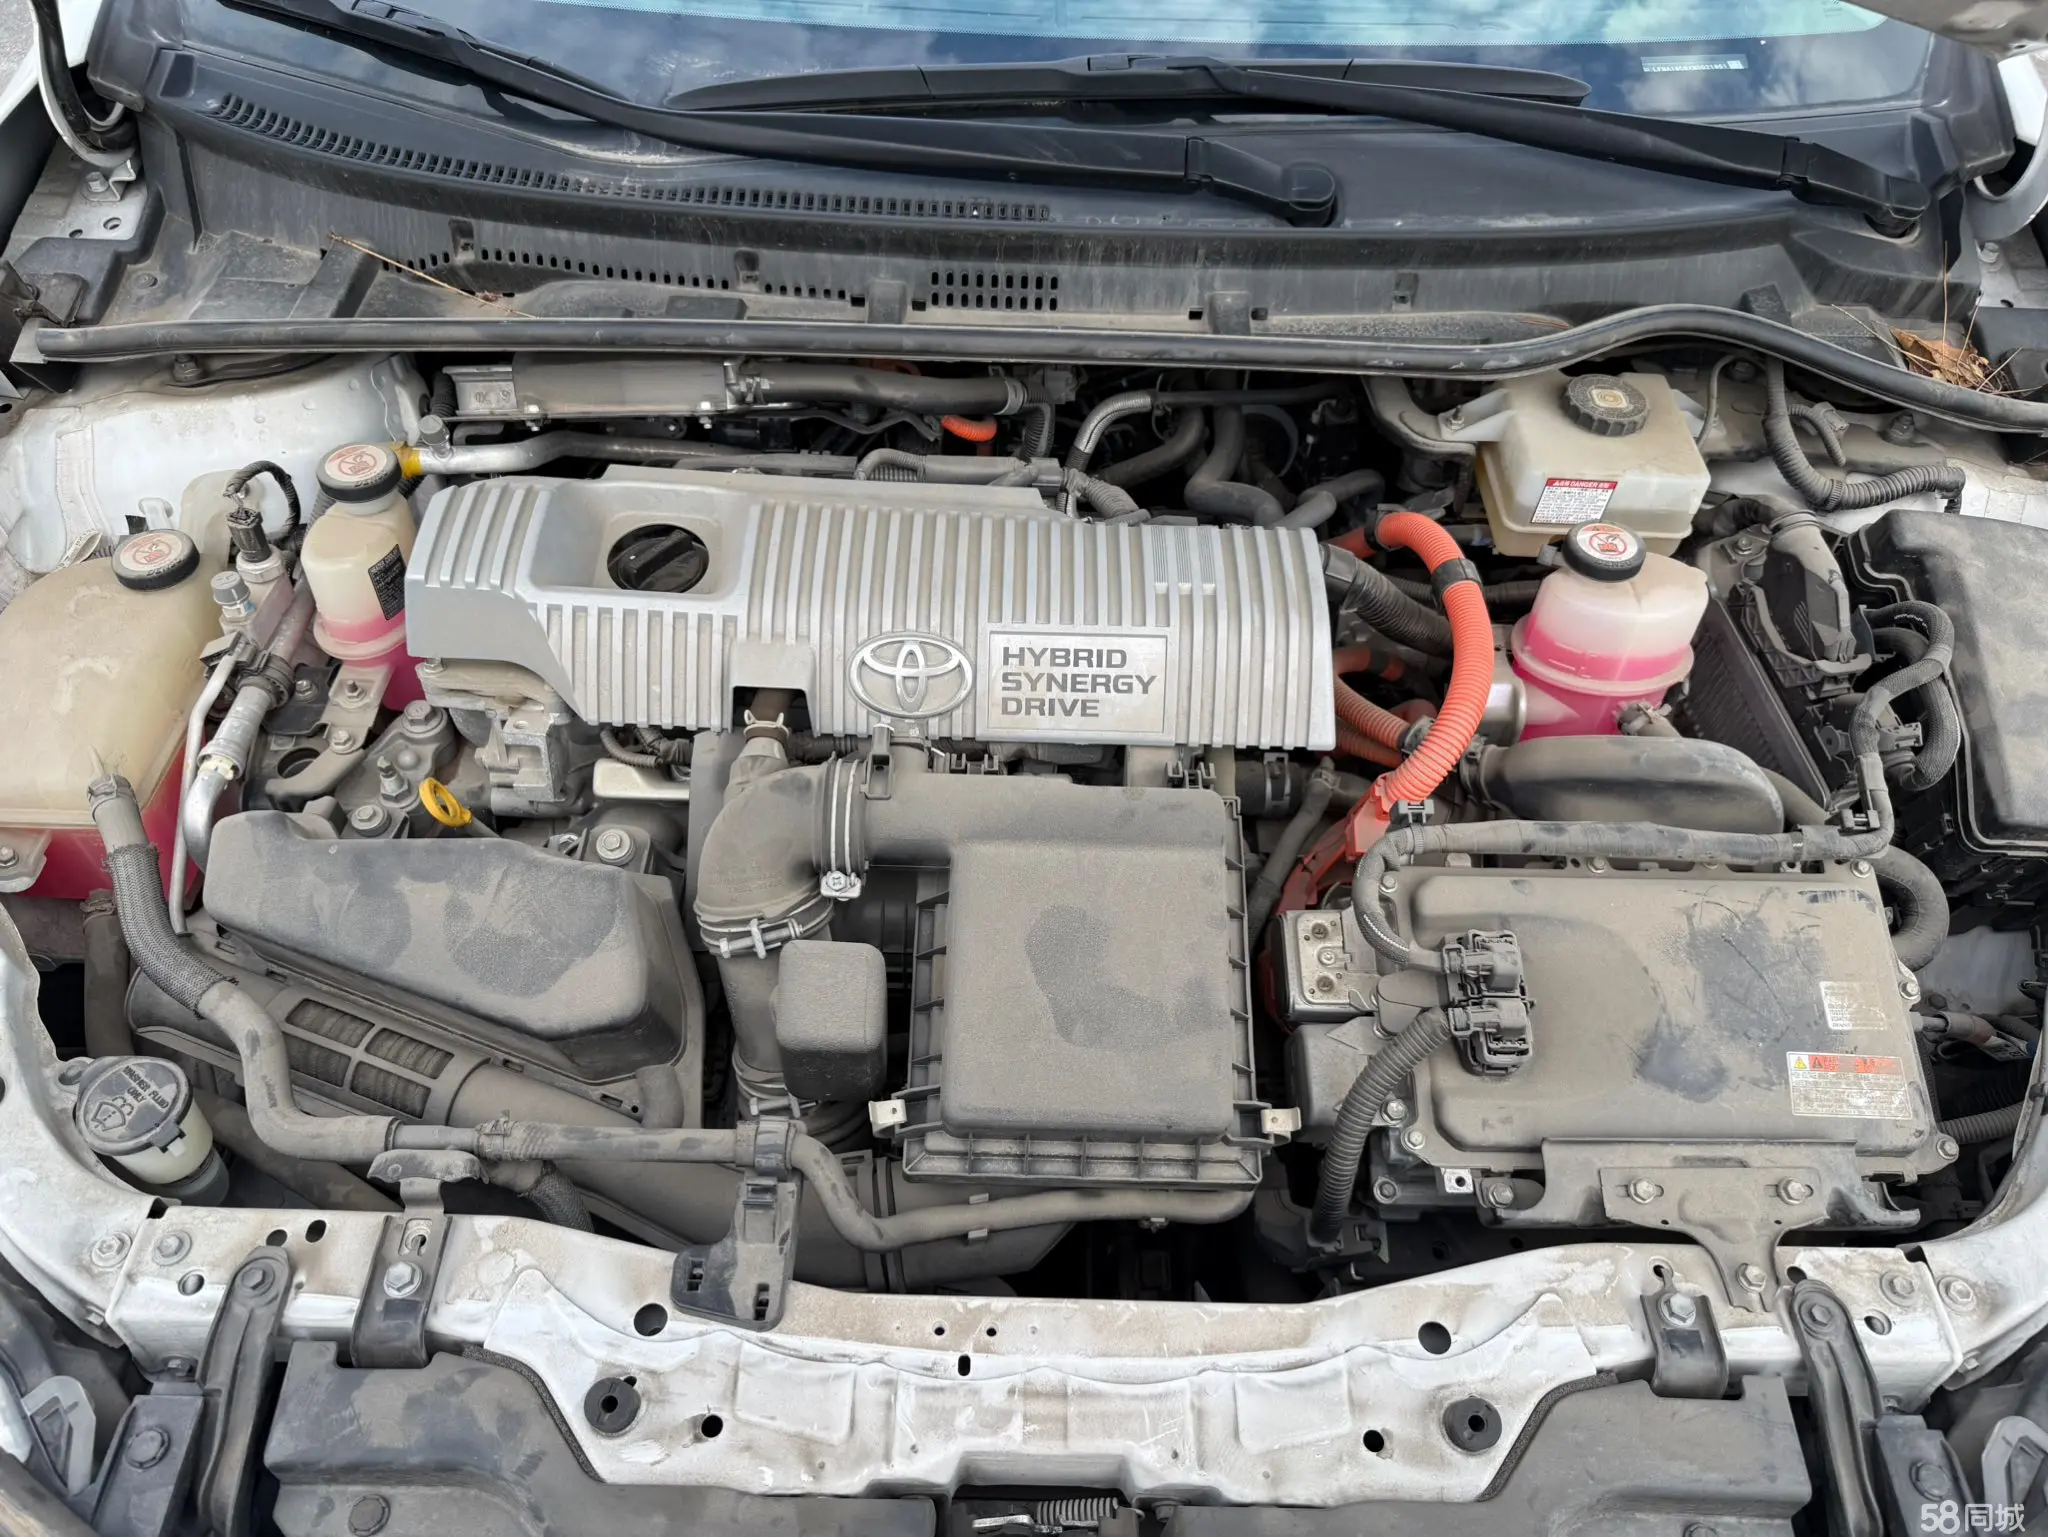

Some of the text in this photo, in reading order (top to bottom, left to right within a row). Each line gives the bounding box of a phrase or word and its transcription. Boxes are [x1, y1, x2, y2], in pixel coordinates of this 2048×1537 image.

[1002, 647, 1127, 668] HYBRID
[1001, 672, 1158, 694] SYNERGY
[1001, 697, 1100, 717] DRIVE
[123, 1065, 169, 1109] WASHER FLUID
[127, 1086, 147, 1103] ONLY
